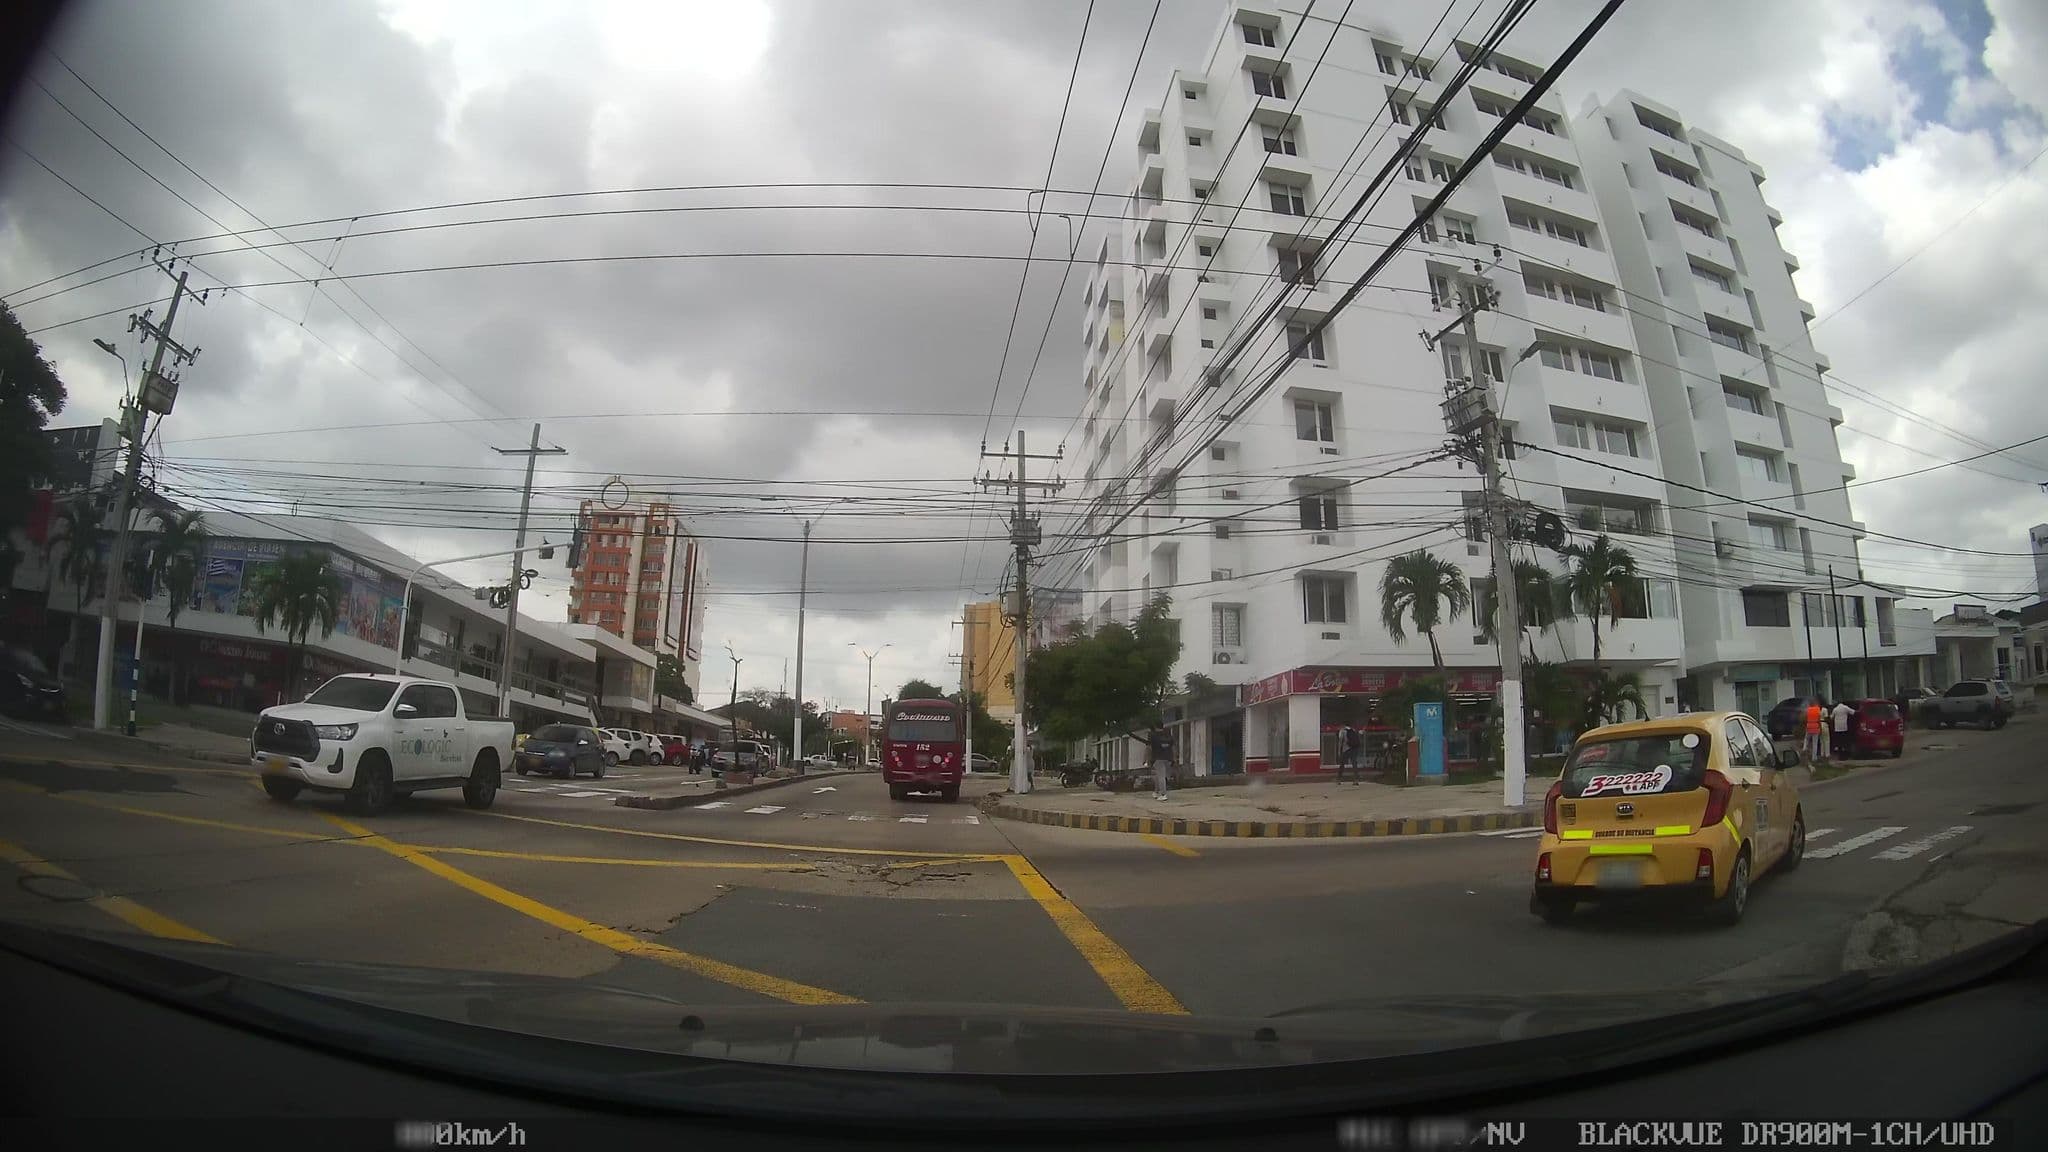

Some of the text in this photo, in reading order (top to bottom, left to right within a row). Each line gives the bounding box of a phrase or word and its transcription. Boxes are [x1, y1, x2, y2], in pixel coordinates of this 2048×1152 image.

[400, 738, 453, 755] ECOLOGIC
[1640, 781, 1661, 791] APP
[1625, 828, 1655, 836] DISTANCIA
